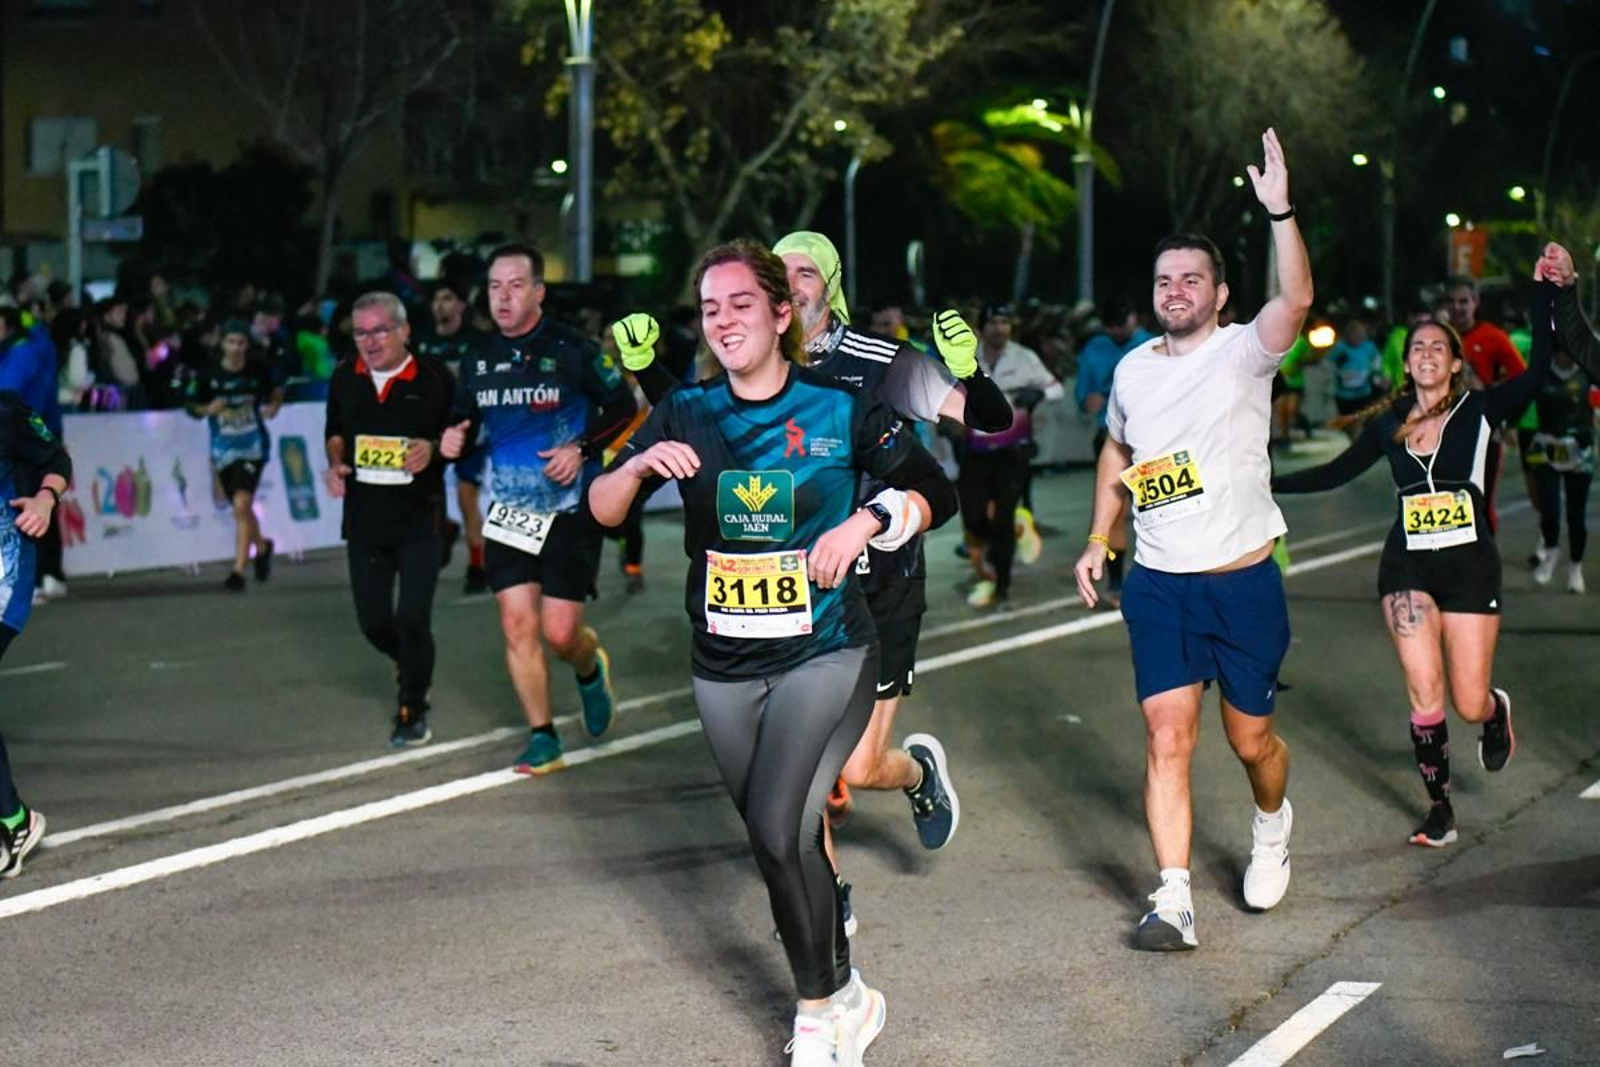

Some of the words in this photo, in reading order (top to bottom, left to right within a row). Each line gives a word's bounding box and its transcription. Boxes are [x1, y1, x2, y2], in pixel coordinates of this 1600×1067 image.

[502, 384, 560, 405] ANTÓN
[496, 506, 543, 534] 9523
[724, 514, 749, 523] CAJA
[752, 514, 788, 523] RURAL
[1410, 505, 1467, 529] 3424
[713, 576, 798, 606] 3118
